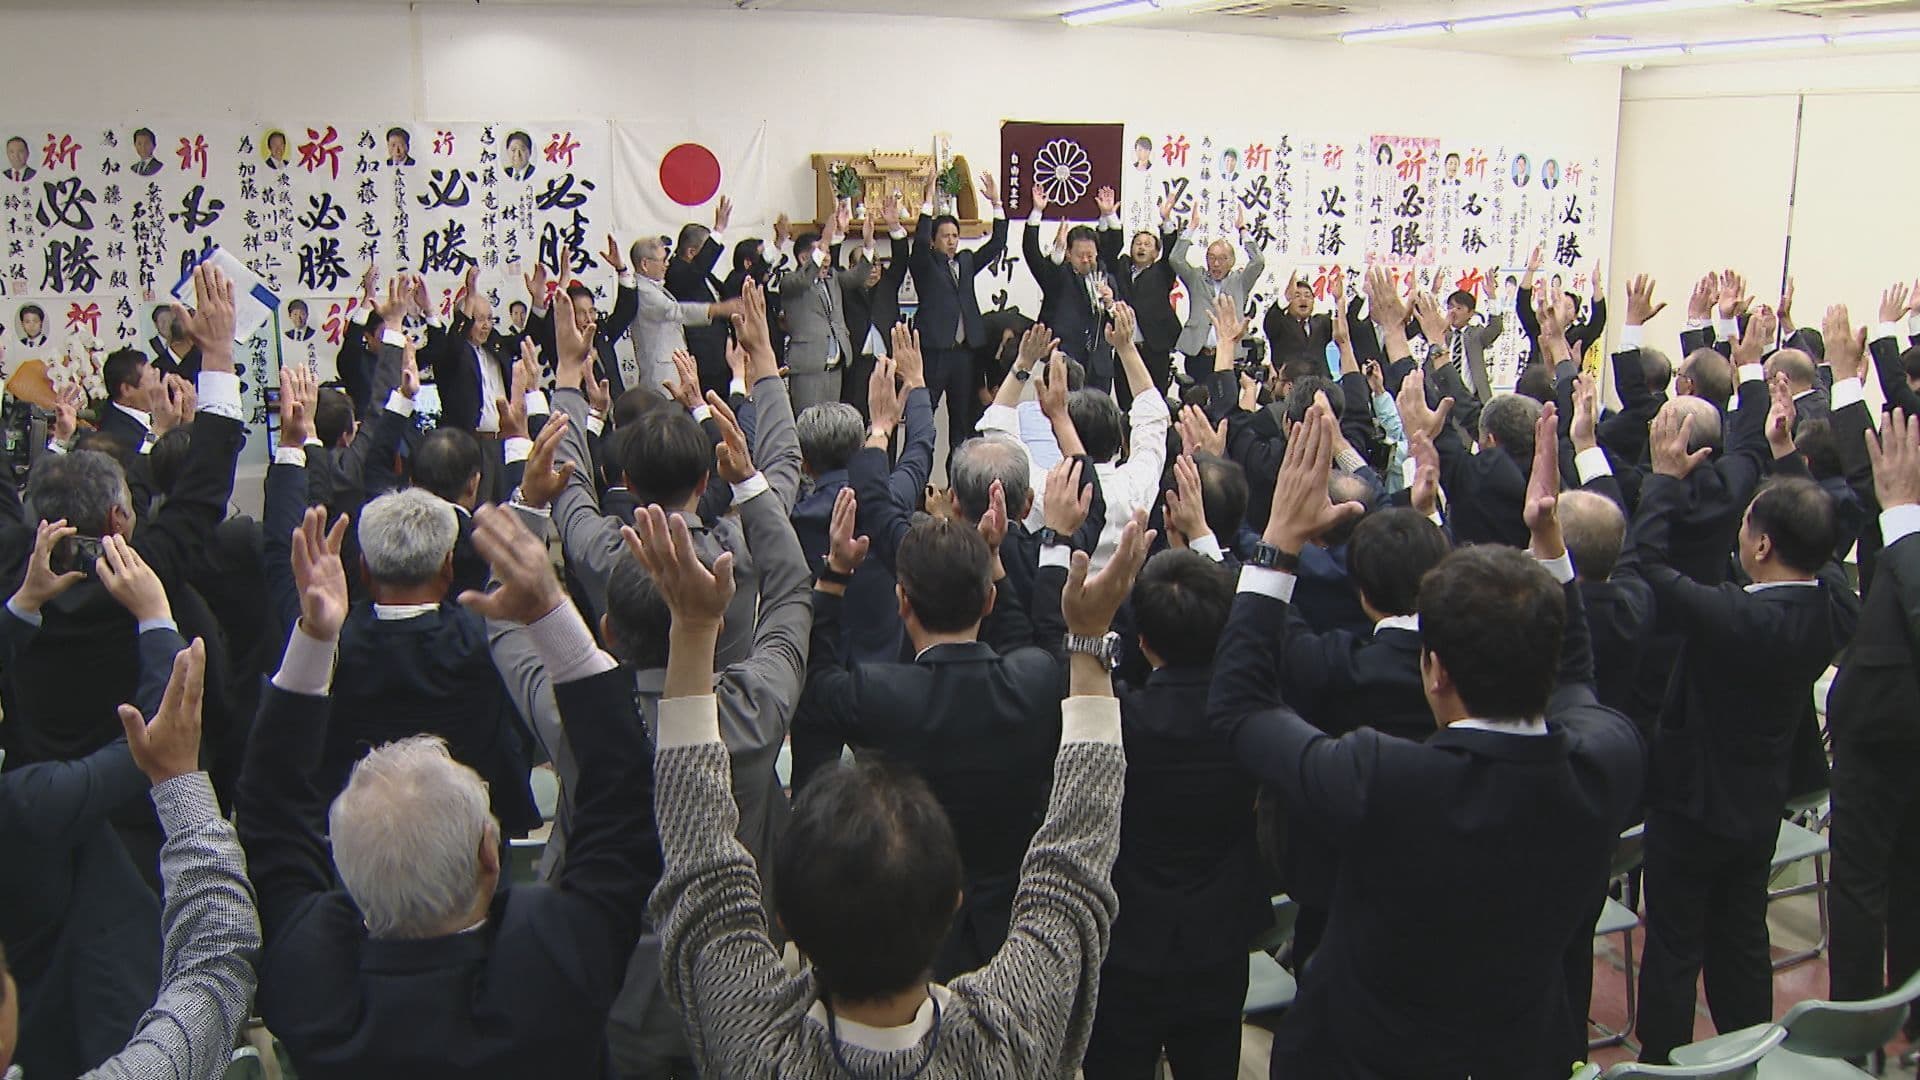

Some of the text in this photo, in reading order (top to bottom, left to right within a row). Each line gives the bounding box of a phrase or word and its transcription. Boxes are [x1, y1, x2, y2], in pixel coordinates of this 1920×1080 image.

[175, 134, 208, 178] 祈
[432, 130, 456, 155] 祈
[543, 132, 581, 168] 祈
[1161, 135, 1190, 168] 祈
[1243, 143, 1272, 172] 祈
[1396, 149, 1427, 183] 祈
[35, 133, 102, 294] 祈 必勝
[297, 126, 351, 292] 祈 必勝
[353, 129, 381, 292] 為加藤竜祥
[1009, 151, 1020, 210] 自由民主党
[1316, 143, 1347, 256] 祈 必勝
[1461, 147, 1488, 254] 祈 必勝
[1554, 161, 1583, 268] 祈 必勝
[262, 186, 283, 293] 黄川田仁志
[416, 168, 479, 276] 必勝
[501, 204, 522, 264] 林芳正
[535, 173, 599, 277] 必勝
[1391, 184, 1427, 258] 必勝
[64, 302, 102, 338] 祈
